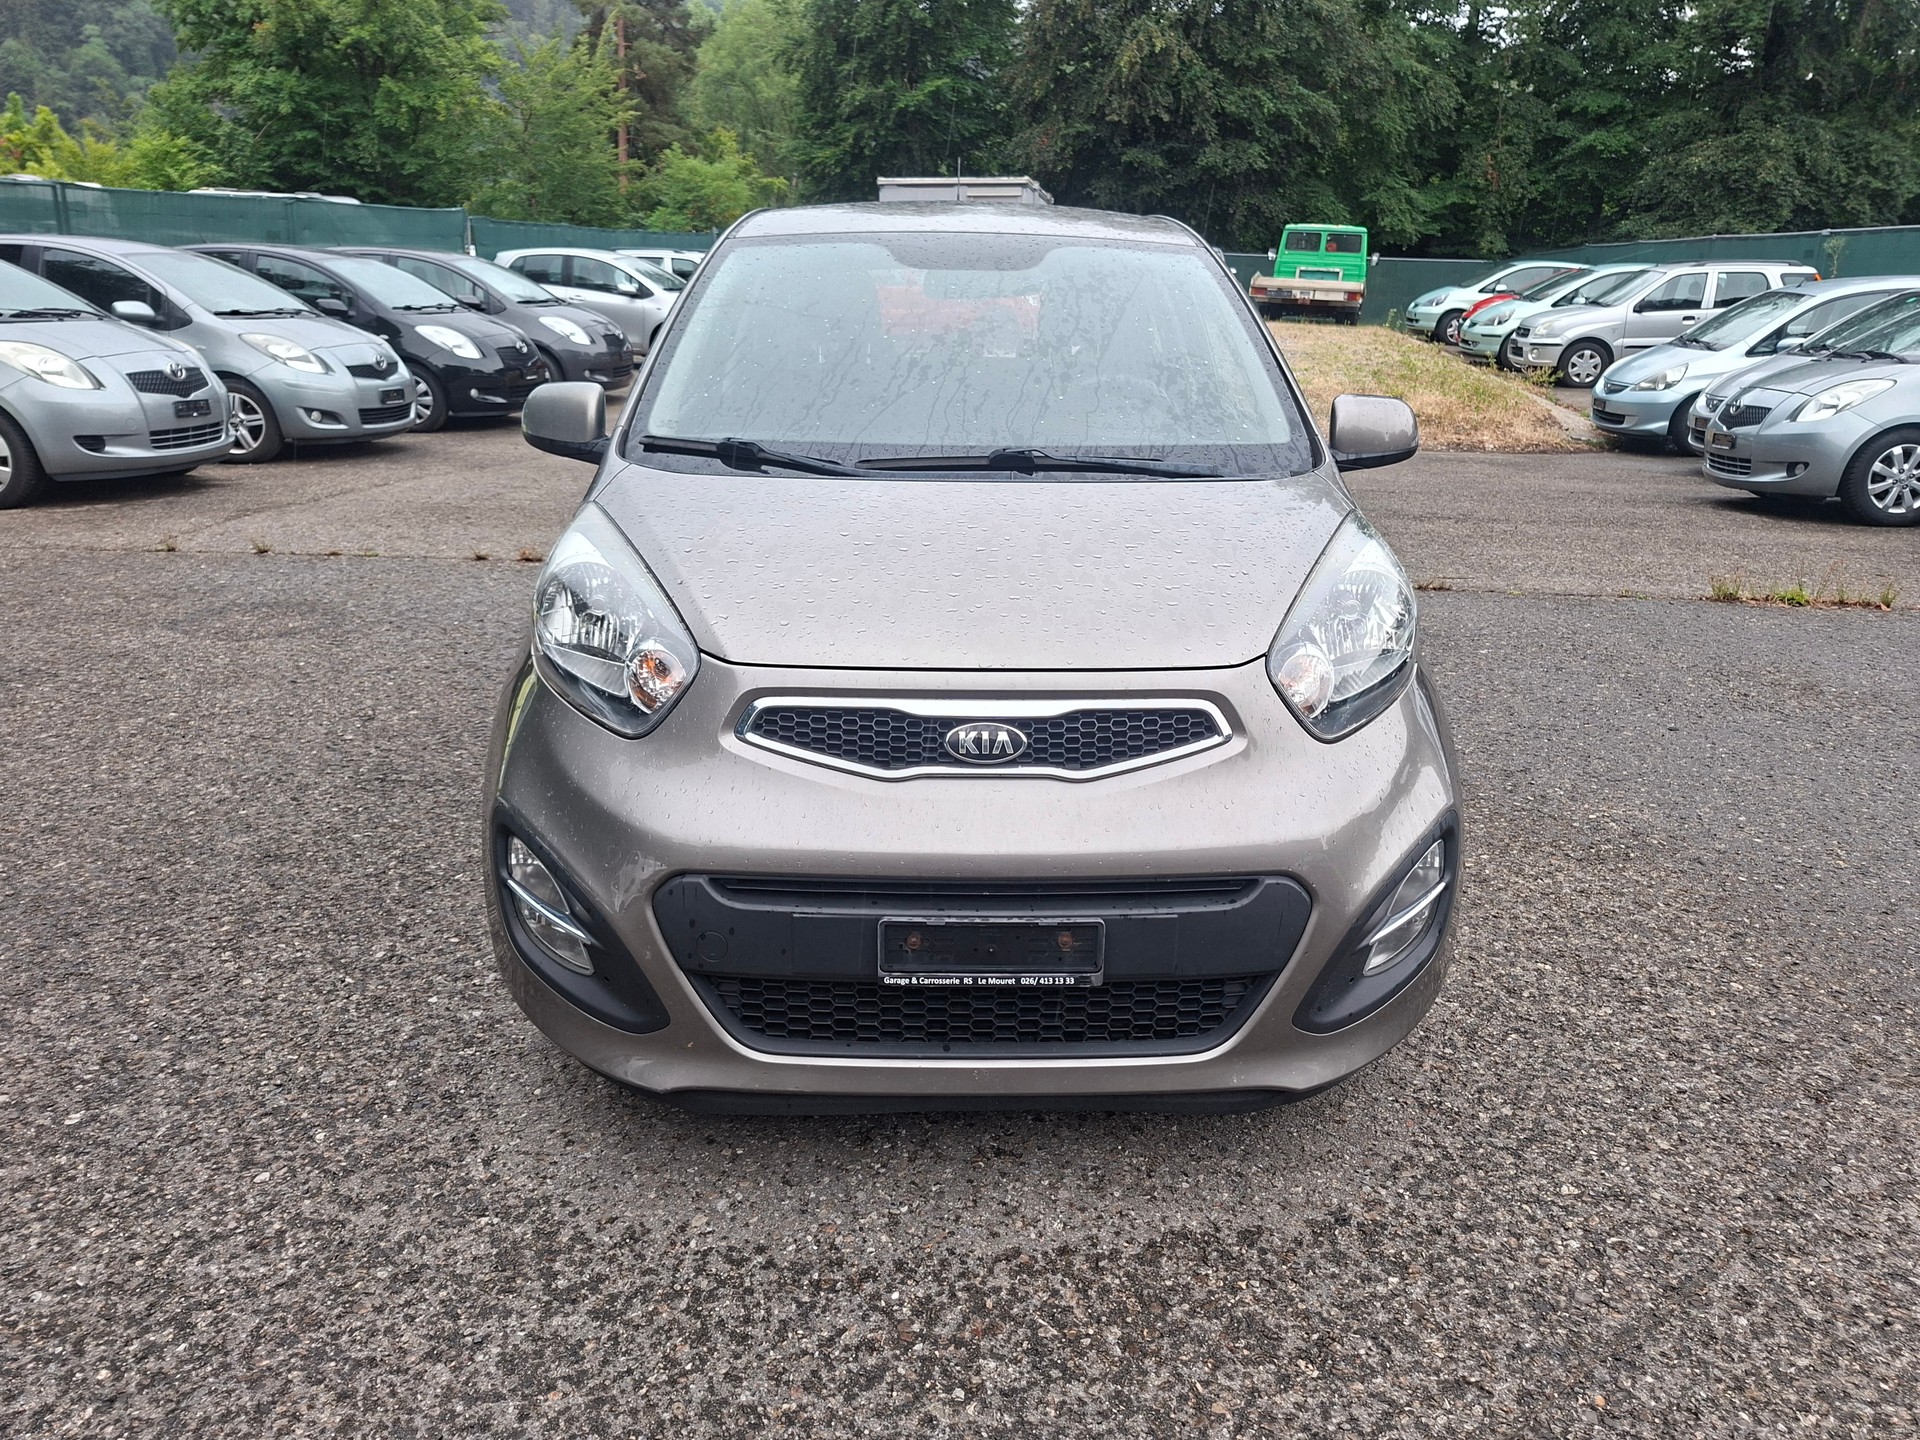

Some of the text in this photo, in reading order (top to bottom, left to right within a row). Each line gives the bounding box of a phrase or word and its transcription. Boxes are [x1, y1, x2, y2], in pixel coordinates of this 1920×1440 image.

[958, 731, 1014, 754] KIA
[884, 976, 910, 985] Garage
[911, 976, 918, 984] &
